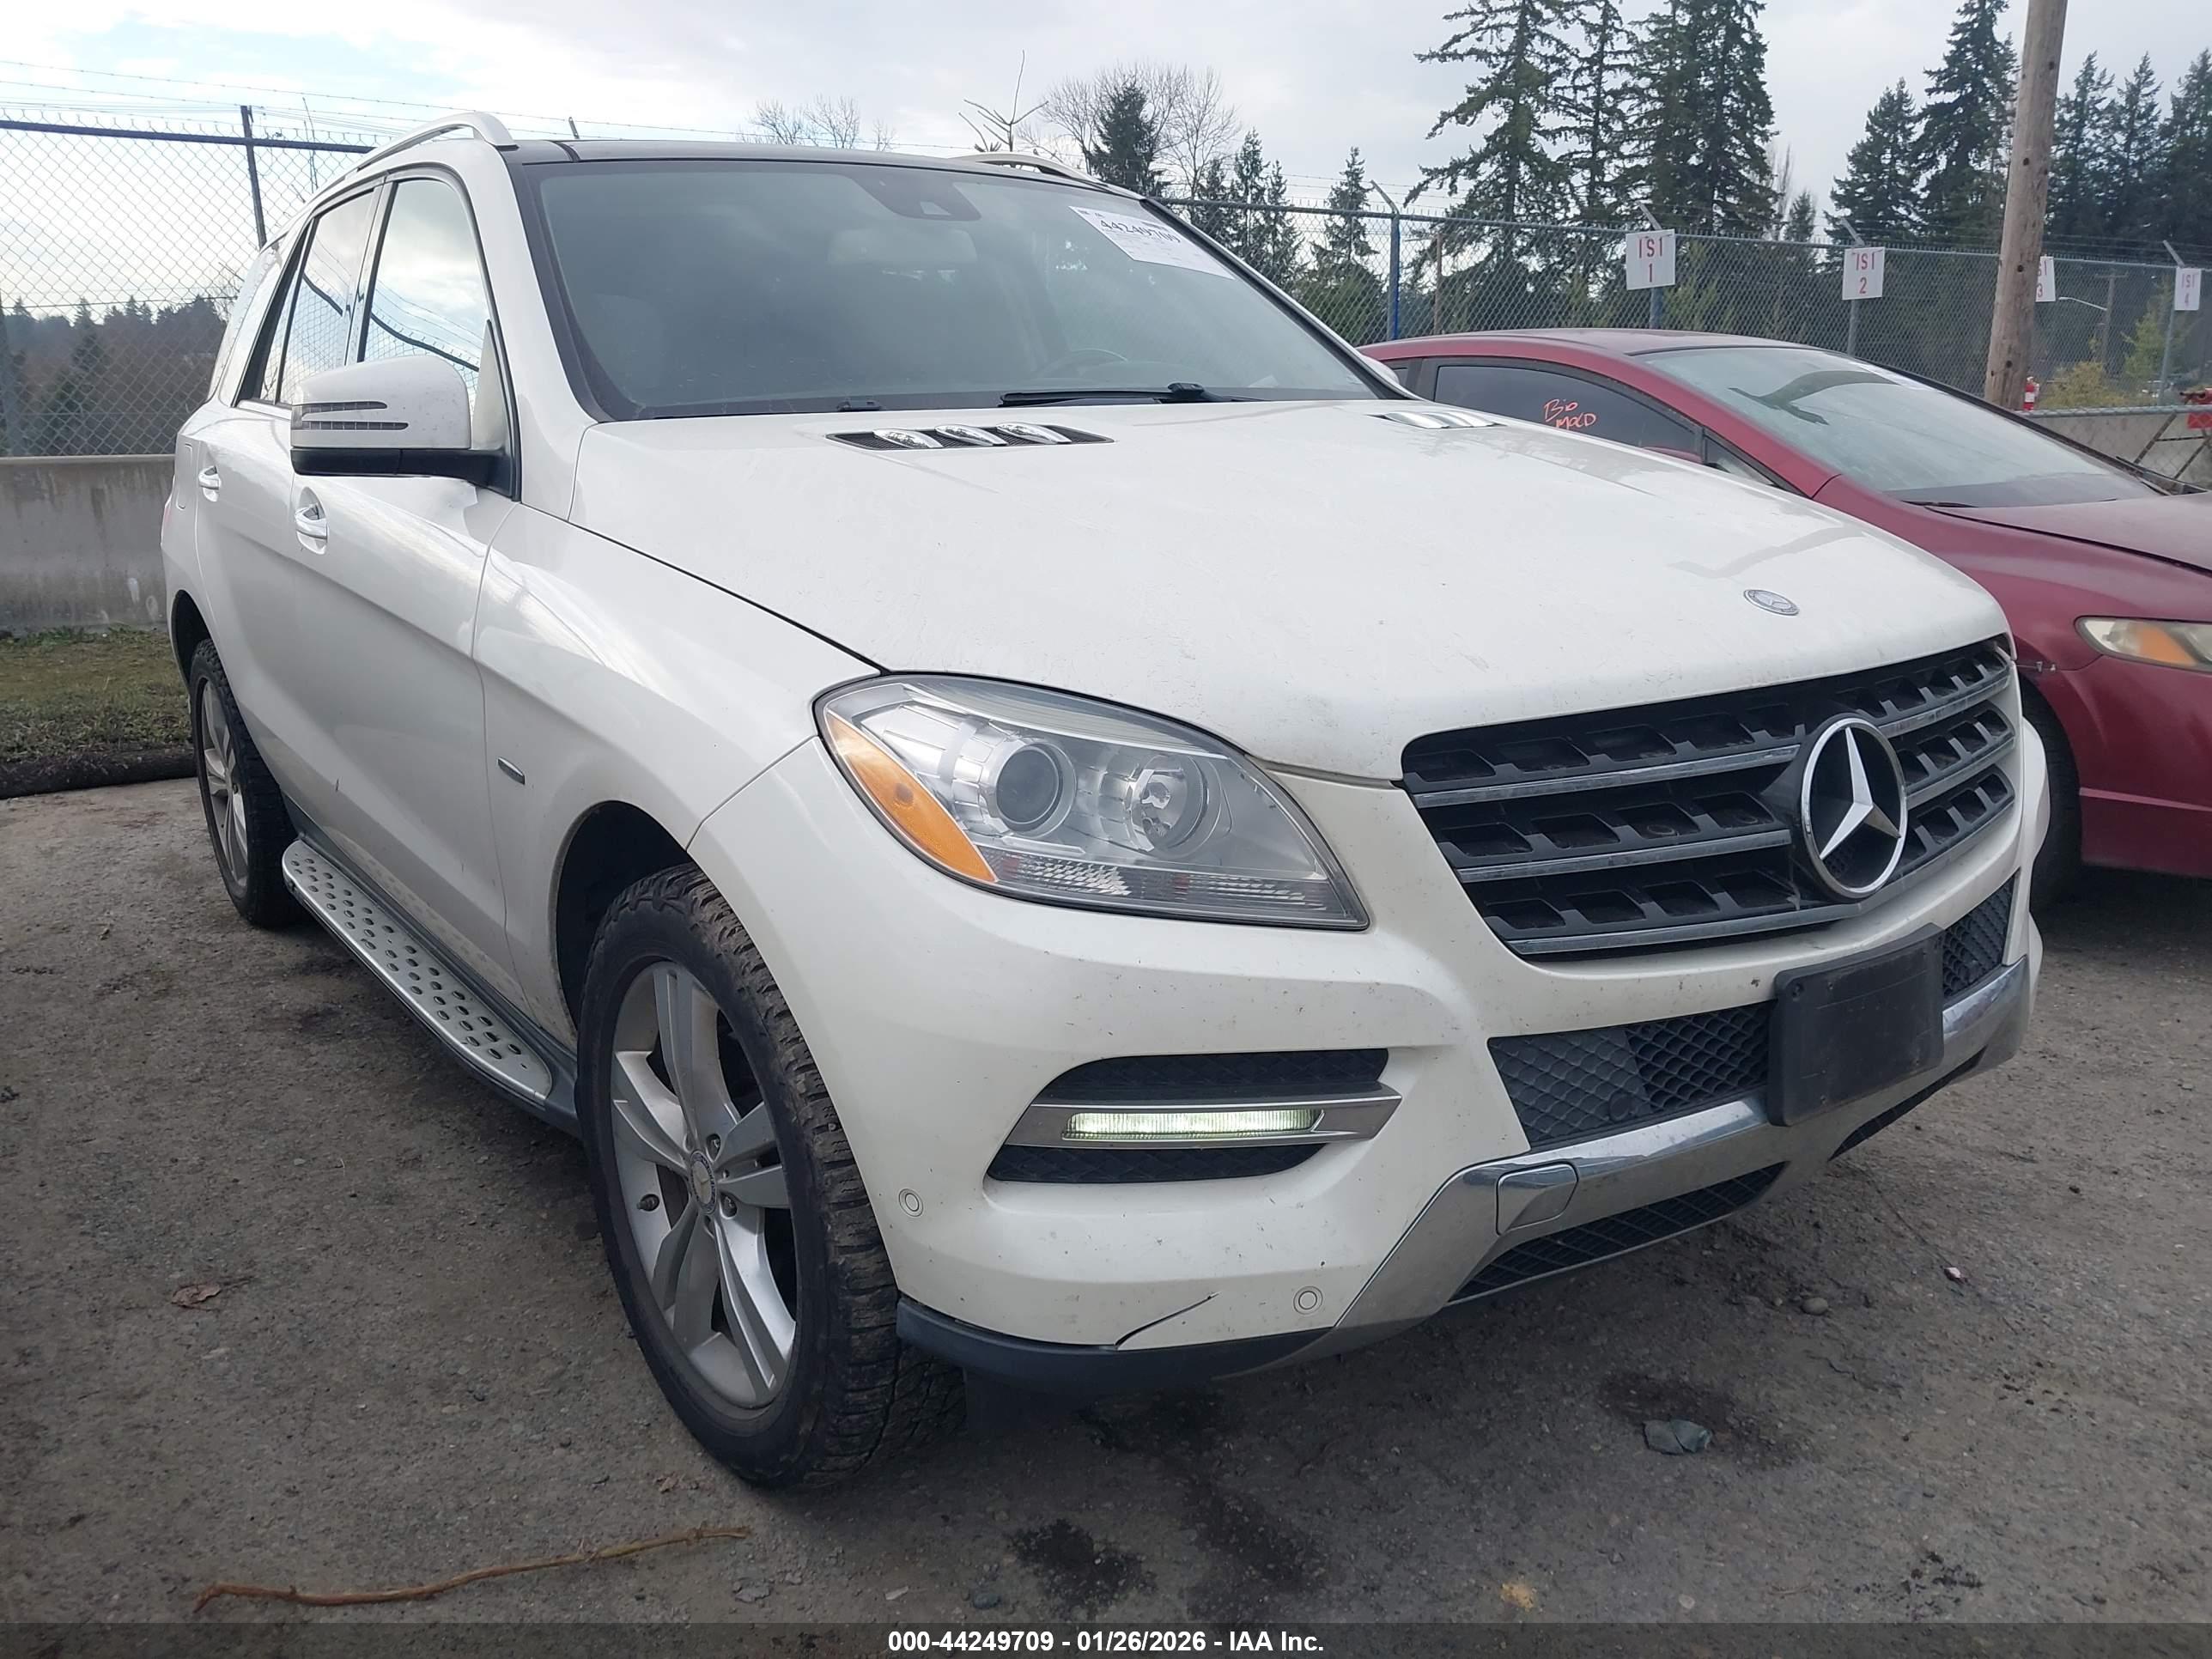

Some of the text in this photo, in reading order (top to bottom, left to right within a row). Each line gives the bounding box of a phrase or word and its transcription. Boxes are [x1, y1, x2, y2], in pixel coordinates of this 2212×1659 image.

[1648, 263, 1653, 283] 1
[1859, 276, 1868, 295] 2
[2035, 283, 2044, 298] 3
